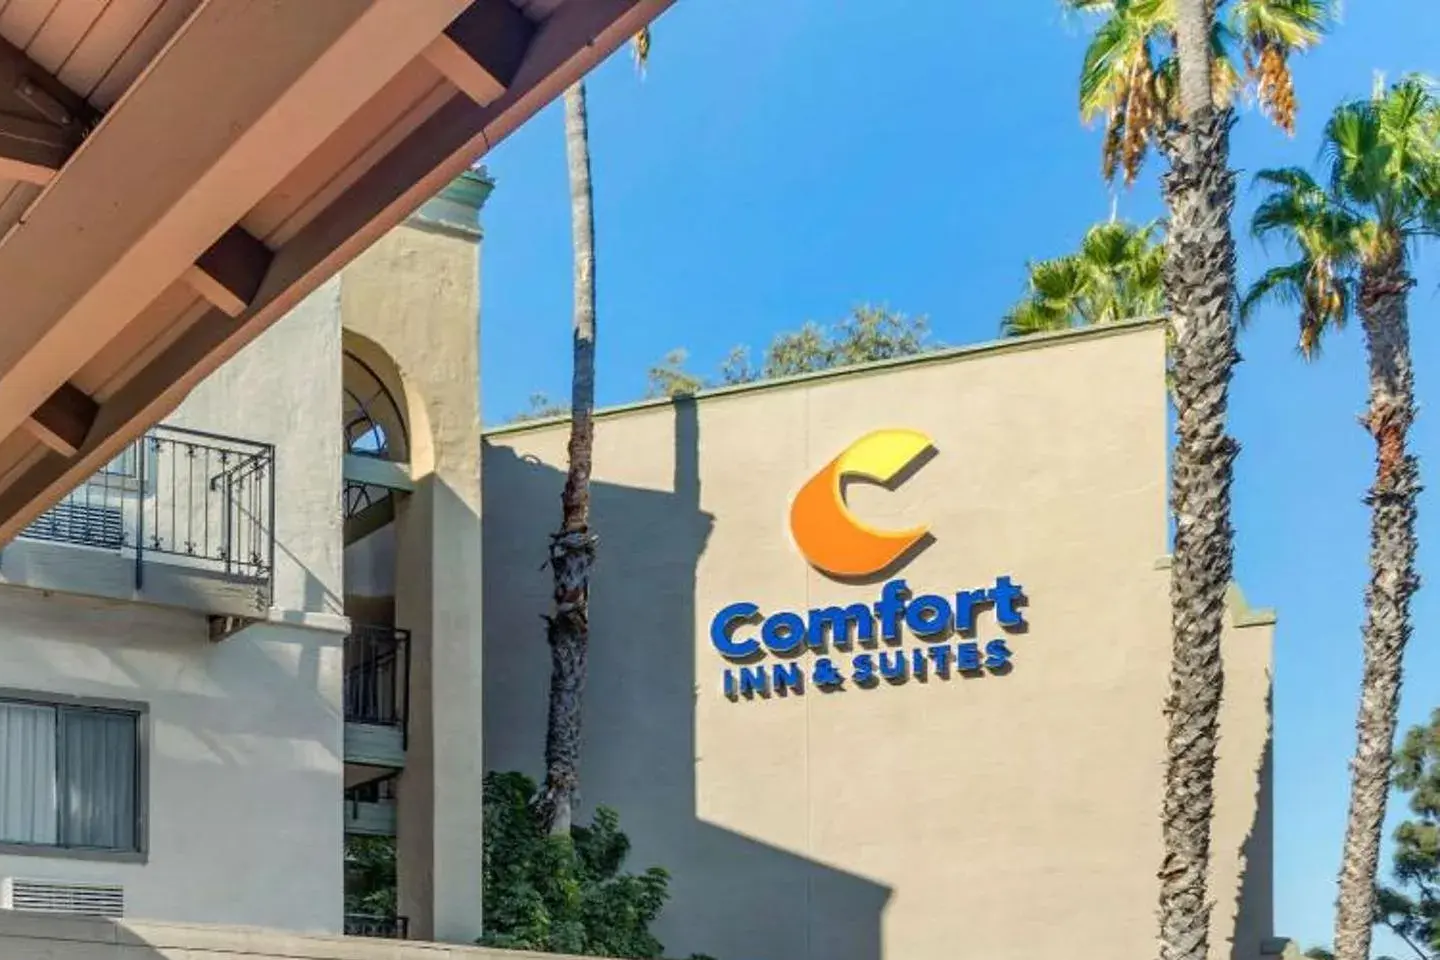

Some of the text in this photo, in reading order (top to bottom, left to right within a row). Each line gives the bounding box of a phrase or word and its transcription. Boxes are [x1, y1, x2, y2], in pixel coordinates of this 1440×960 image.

[710, 576, 1024, 657] Comfort
[723, 639, 1013, 697] INN & SUITES
